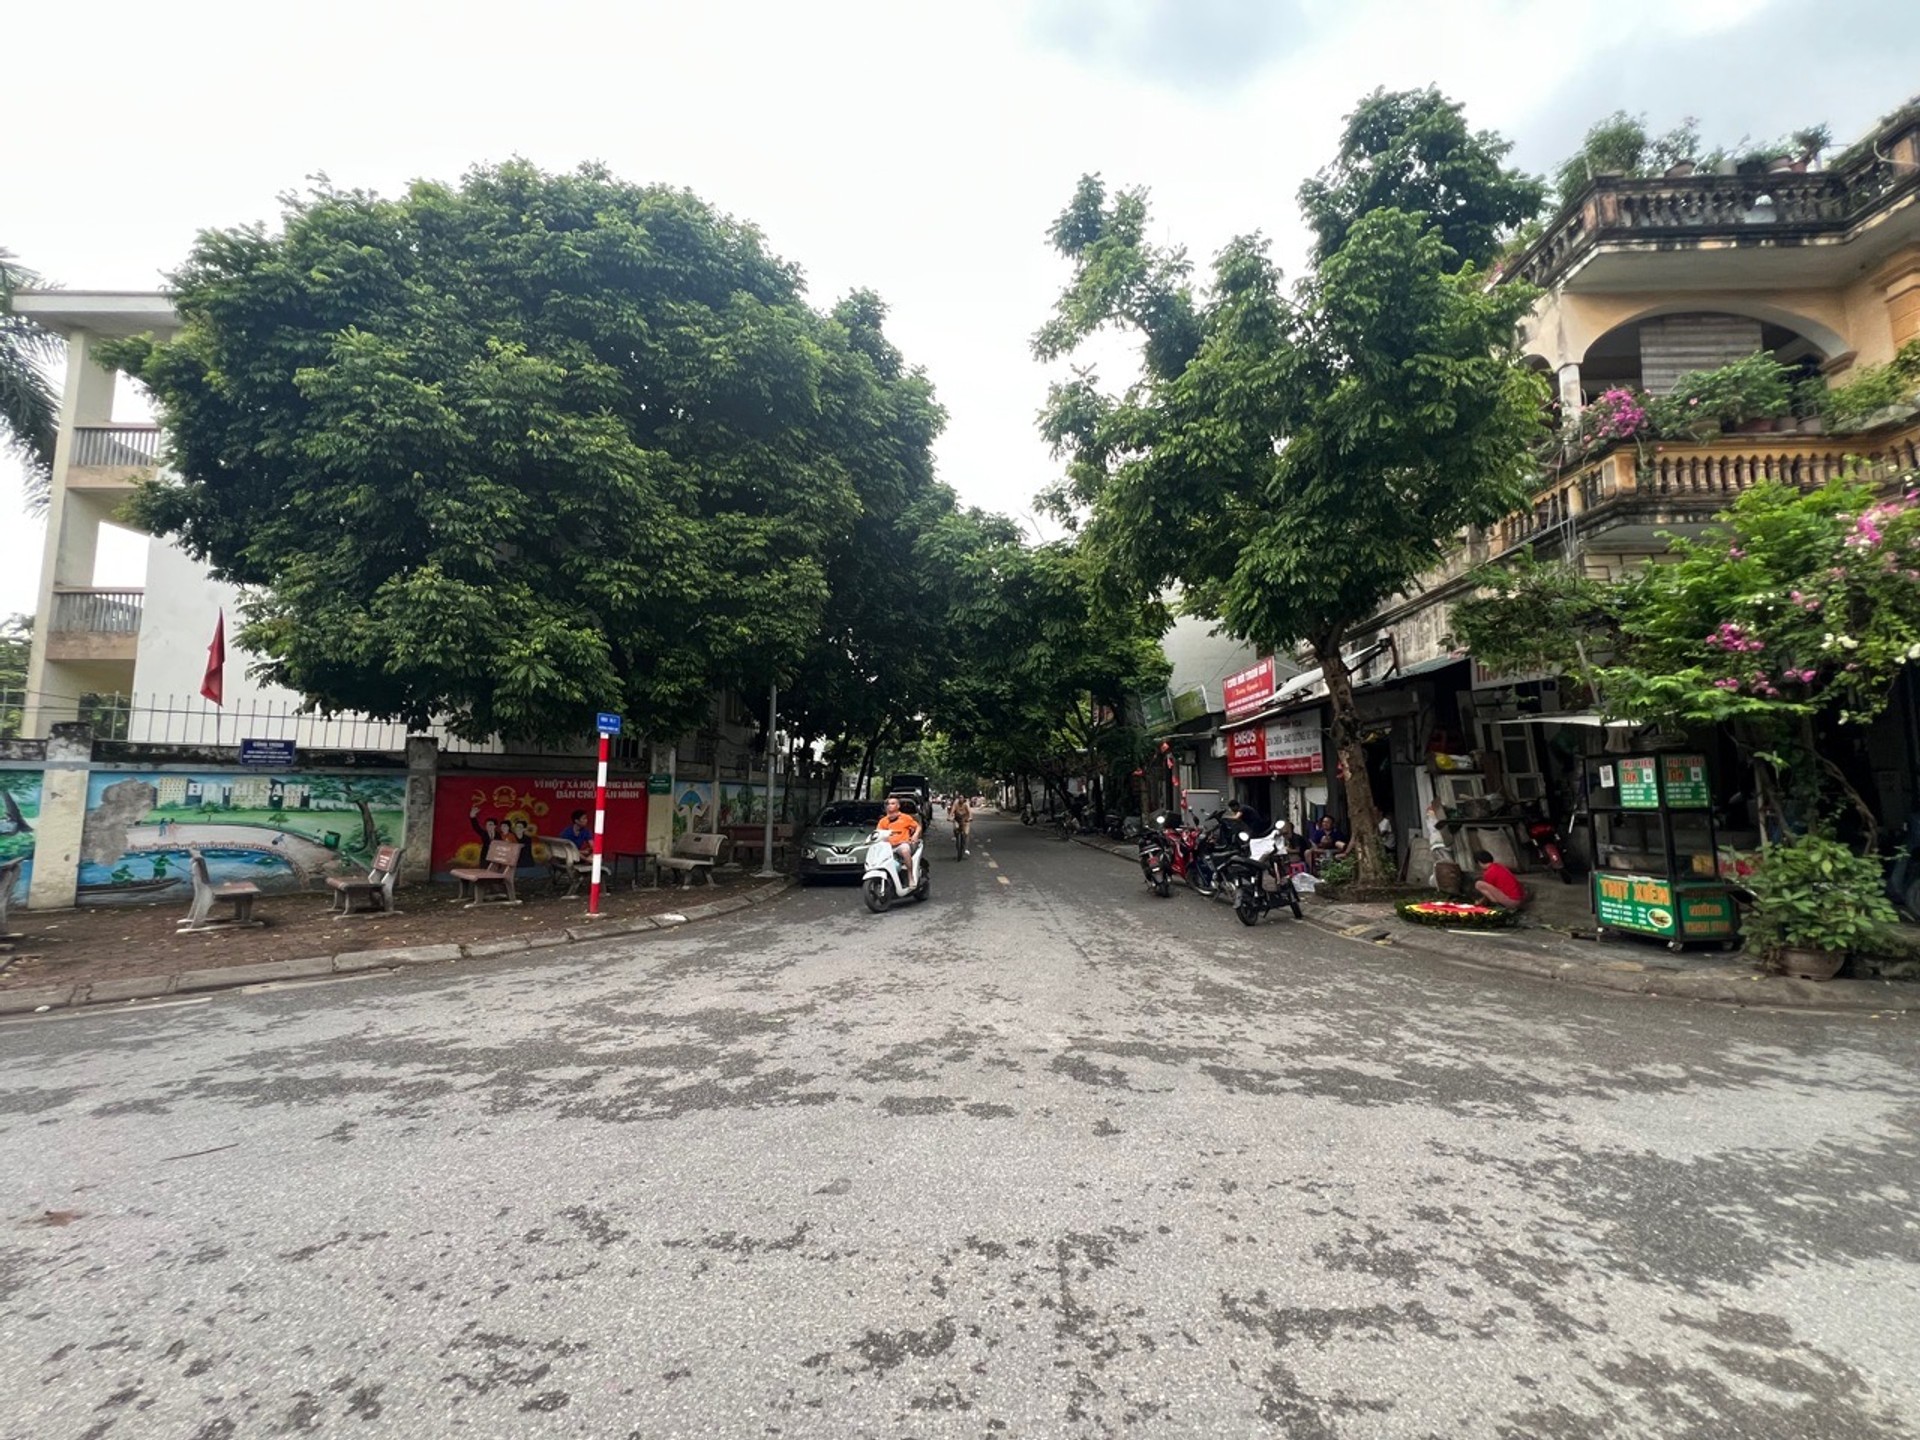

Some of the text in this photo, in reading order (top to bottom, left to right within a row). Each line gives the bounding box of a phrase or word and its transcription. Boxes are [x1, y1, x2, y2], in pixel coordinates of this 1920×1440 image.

[1233, 729, 1256, 747] ENEOS
[1600, 879, 1672, 907] THỊT XIÊN
